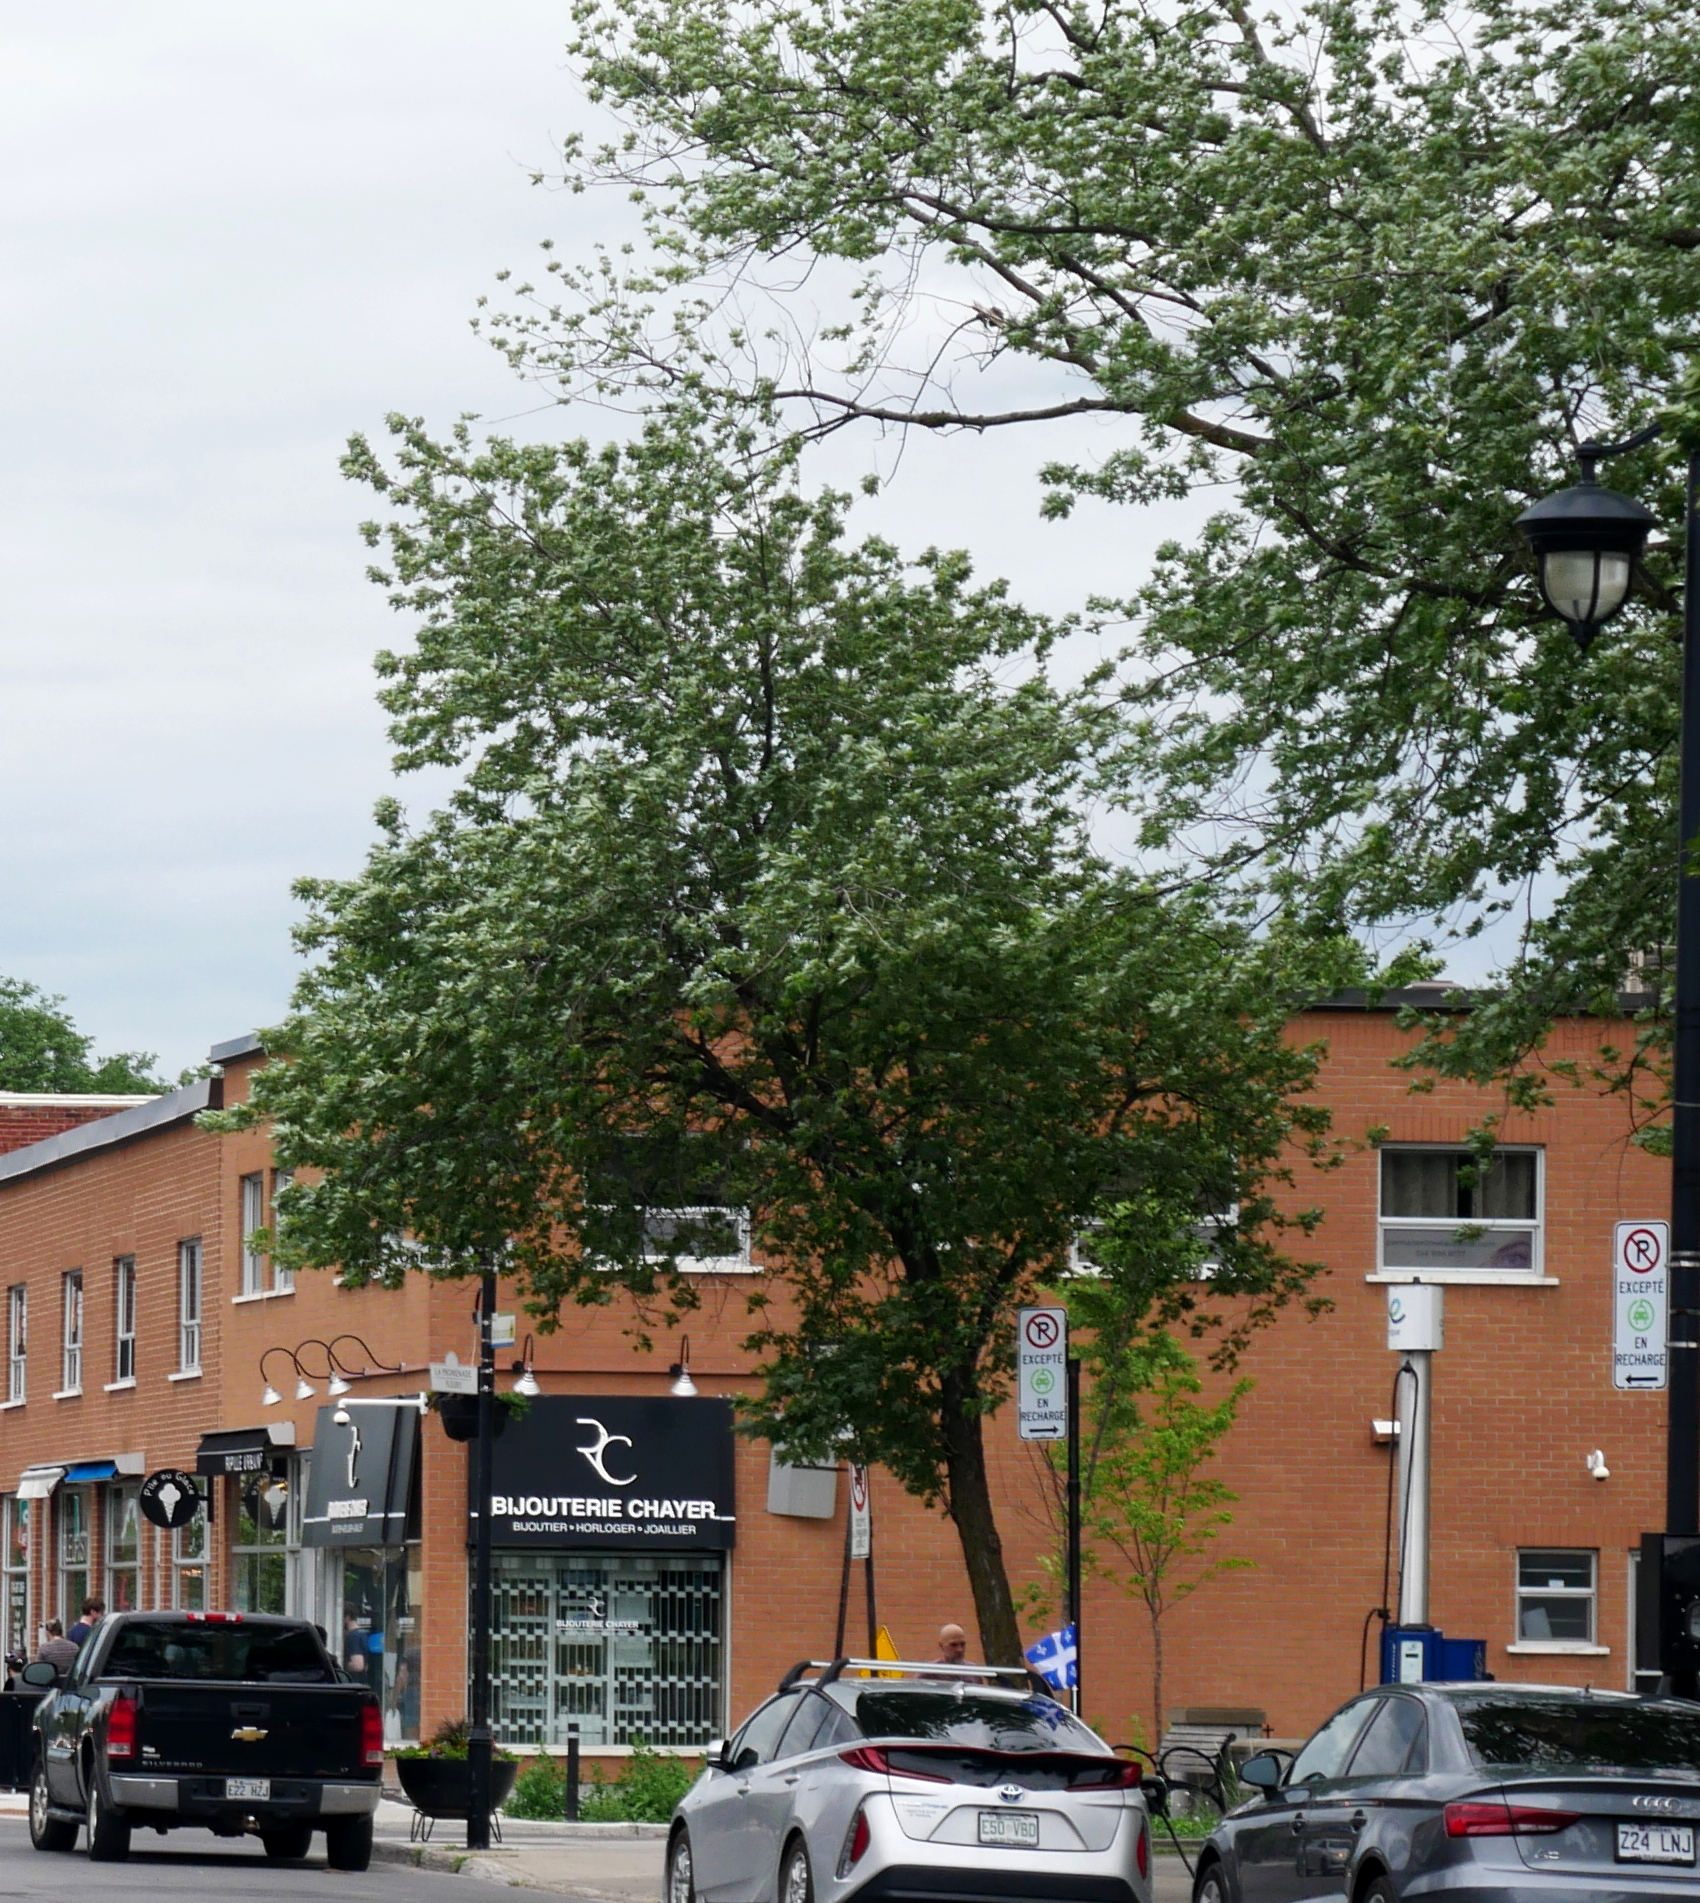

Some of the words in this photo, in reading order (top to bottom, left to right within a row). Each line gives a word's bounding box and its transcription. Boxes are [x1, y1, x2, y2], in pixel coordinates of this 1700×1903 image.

[1619, 1279, 1664, 1294] EXCEPTÉ
[1635, 1337, 1648, 1349] EN
[1022, 1352, 1064, 1365] EXCEPTÉ
[1616, 1353, 1666, 1367] RECHARGE
[1037, 1398, 1049, 1408] EN
[1020, 1411, 1066, 1422] RECHARGE
[143, 1479, 159, 1497] Pile
[491, 1496, 623, 1518] BIJOUTERIE
[628, 1499, 717, 1519] CHAYER
[513, 1521, 568, 1533] BIJOUTIER
[576, 1523, 636, 1535] HORLOGER
[644, 1525, 697, 1535] JOAILLIER
[556, 1619, 604, 1629] BIJOUTERIE
[604, 1620, 640, 1629] CHAYER
[228, 1785, 246, 1797] E22
[981, 1819, 1005, 1836] E50
[1013, 1822, 1037, 1838] VBD
[1619, 1830, 1650, 1851] Z24
[1661, 1833, 1691, 1853] LNJ
